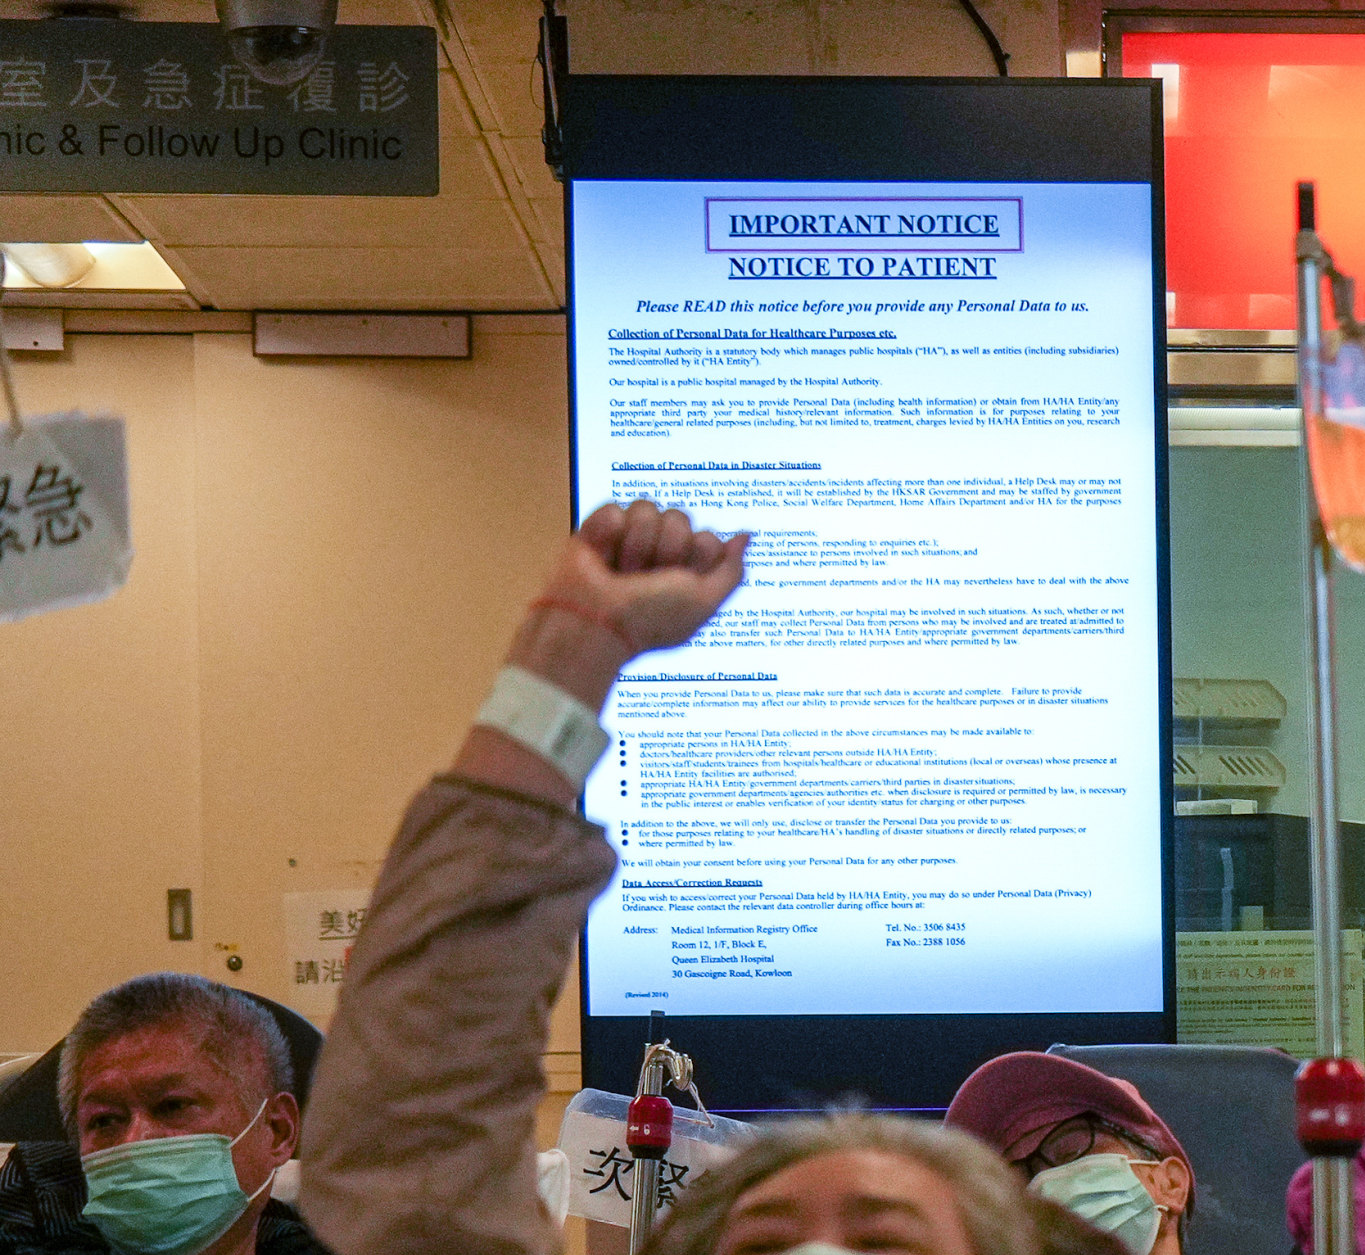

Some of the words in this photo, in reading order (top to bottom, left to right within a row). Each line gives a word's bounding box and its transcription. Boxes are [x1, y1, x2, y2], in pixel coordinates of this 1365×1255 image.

[58, 126, 84, 157] &
[99, 124, 220, 158] Follow
[234, 127, 285, 165] Up
[299, 126, 402, 161] Clinic
[729, 214, 890, 234] IMPORTANT
[897, 214, 998, 234] NOTICE
[728, 257, 830, 277] NOTICE
[837, 257, 874, 277] TO
[882, 257, 996, 277] PATIENT
[636, 300, 679, 312] Please
[683, 299, 726, 312] READ
[730, 299, 754, 312] this
[758, 299, 798, 312] notice
[802, 299, 844, 315] before
[846, 303, 872, 315] you
[874, 299, 925, 315] provide
[928, 303, 953, 315] any
[957, 299, 1015, 311] Personal
[1019, 299, 1050, 311] Data
[1054, 301, 1066, 311] to
[1071, 303, 1088, 311] us.
[607, 328, 659, 339] Collection
[662, 328, 674, 339] of
[676, 328, 720, 339] Personal
[724, 328, 748, 339] Data
[751, 328, 767, 339] for
[770, 328, 826, 339] Healthcare
[829, 328, 876, 339] Purposes
[878, 329, 896, 339] etc.
[608, 377, 625, 386] Our
[626, 378, 659, 388] hospital
[677, 377, 702, 387] public
[704, 377, 737, 387] hospital
[739, 377, 775, 387] managed
[777, 377, 787, 387] by
[789, 377, 802, 385] the
[804, 377, 838, 387] Hospital
[841, 377, 883, 387] Authority.
[622, 879, 642, 888] Data
[646, 879, 722, 888] Access/Correction
[724, 878, 763, 888] Requests
[623, 925, 657, 934] Address:
[671, 926, 704, 934] Medical
[706, 925, 754, 933] Information
[756, 925, 789, 935] Registry
[792, 924, 817, 932] Office
[885, 923, 901, 931] Tel.
[903, 923, 921, 931] No.:
[923, 923, 944, 931] 3506
[945, 922, 965, 931] 8435
[671, 941, 696, 949] Room
[699, 940, 711, 949] 12,
[714, 940, 729, 949] 1/F,
[731, 940, 755, 948] Block
[757, 939, 766, 948] E,
[886, 938, 901, 946] Fax
[903, 938, 920, 946] No.:
[922, 937, 943, 946] 2388
[946, 937, 965, 945] 1056
[671, 955, 698, 965] Queen
[700, 955, 738, 963] Elizabeth
[740, 954, 774, 964] Hospital
[672, 969, 683, 978] 30
[684, 969, 727, 979] Gascoigne
[729, 969, 753, 977] Road,
[754, 969, 792, 977] Kowloon
